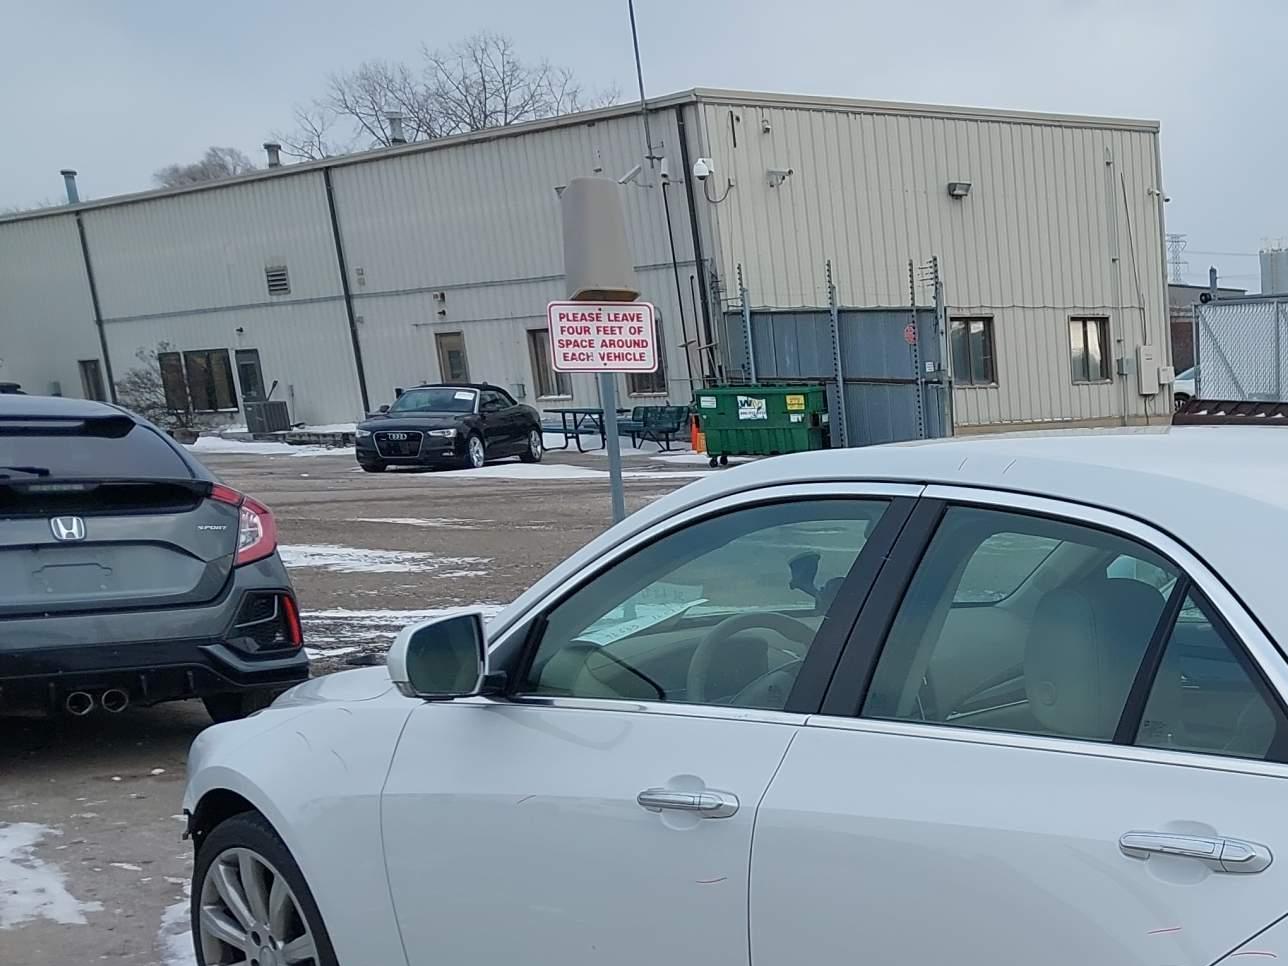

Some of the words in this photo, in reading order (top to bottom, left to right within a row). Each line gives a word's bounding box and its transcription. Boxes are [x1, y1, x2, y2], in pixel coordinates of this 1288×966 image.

[559, 313, 602, 322] PLEASE
[608, 313, 643, 322] LEAVE
[561, 326, 591, 335] FOUR
[597, 326, 623, 335] FEET
[629, 326, 643, 335] OF
[558, 339, 595, 348] SPACE
[601, 339, 648, 348] AROUND
[563, 352, 593, 361] EACH
[599, 352, 646, 361] VEHICLE
